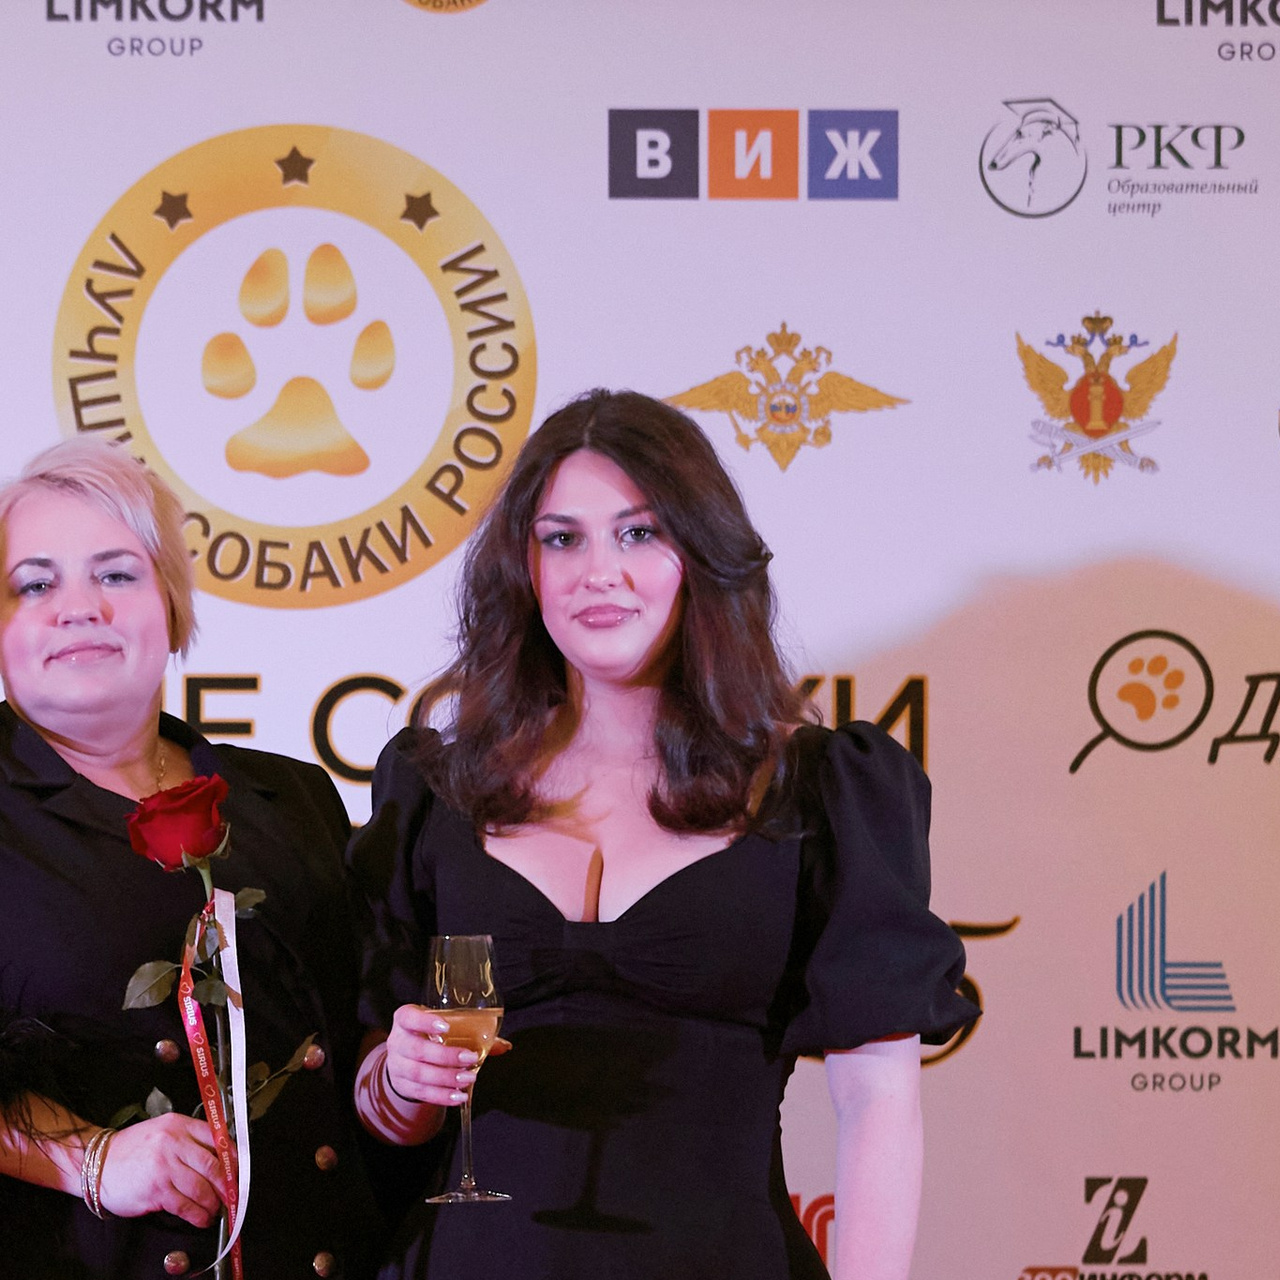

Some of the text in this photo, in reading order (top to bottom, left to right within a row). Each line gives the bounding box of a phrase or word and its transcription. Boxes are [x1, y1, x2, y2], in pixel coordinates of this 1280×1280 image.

[107, 37, 203, 57] GROUP
[1107, 124, 1246, 170] РКФ
[1107, 178, 1259, 199] Образовательный
[1107, 203, 1162, 218] центр
[69, 232, 148, 462] ЛУЧШ
[425, 243, 519, 516] РОССИИ
[183, 996, 197, 1026] SIRIUS
[1073, 1026, 1279, 1059] LIMKORM
[196, 1047, 210, 1078] SIRIUS
[1130, 1073, 1222, 1092] GROUP
[207, 1099, 222, 1131] SIRIUS
[221, 1151, 233, 1182] SIRIUS
